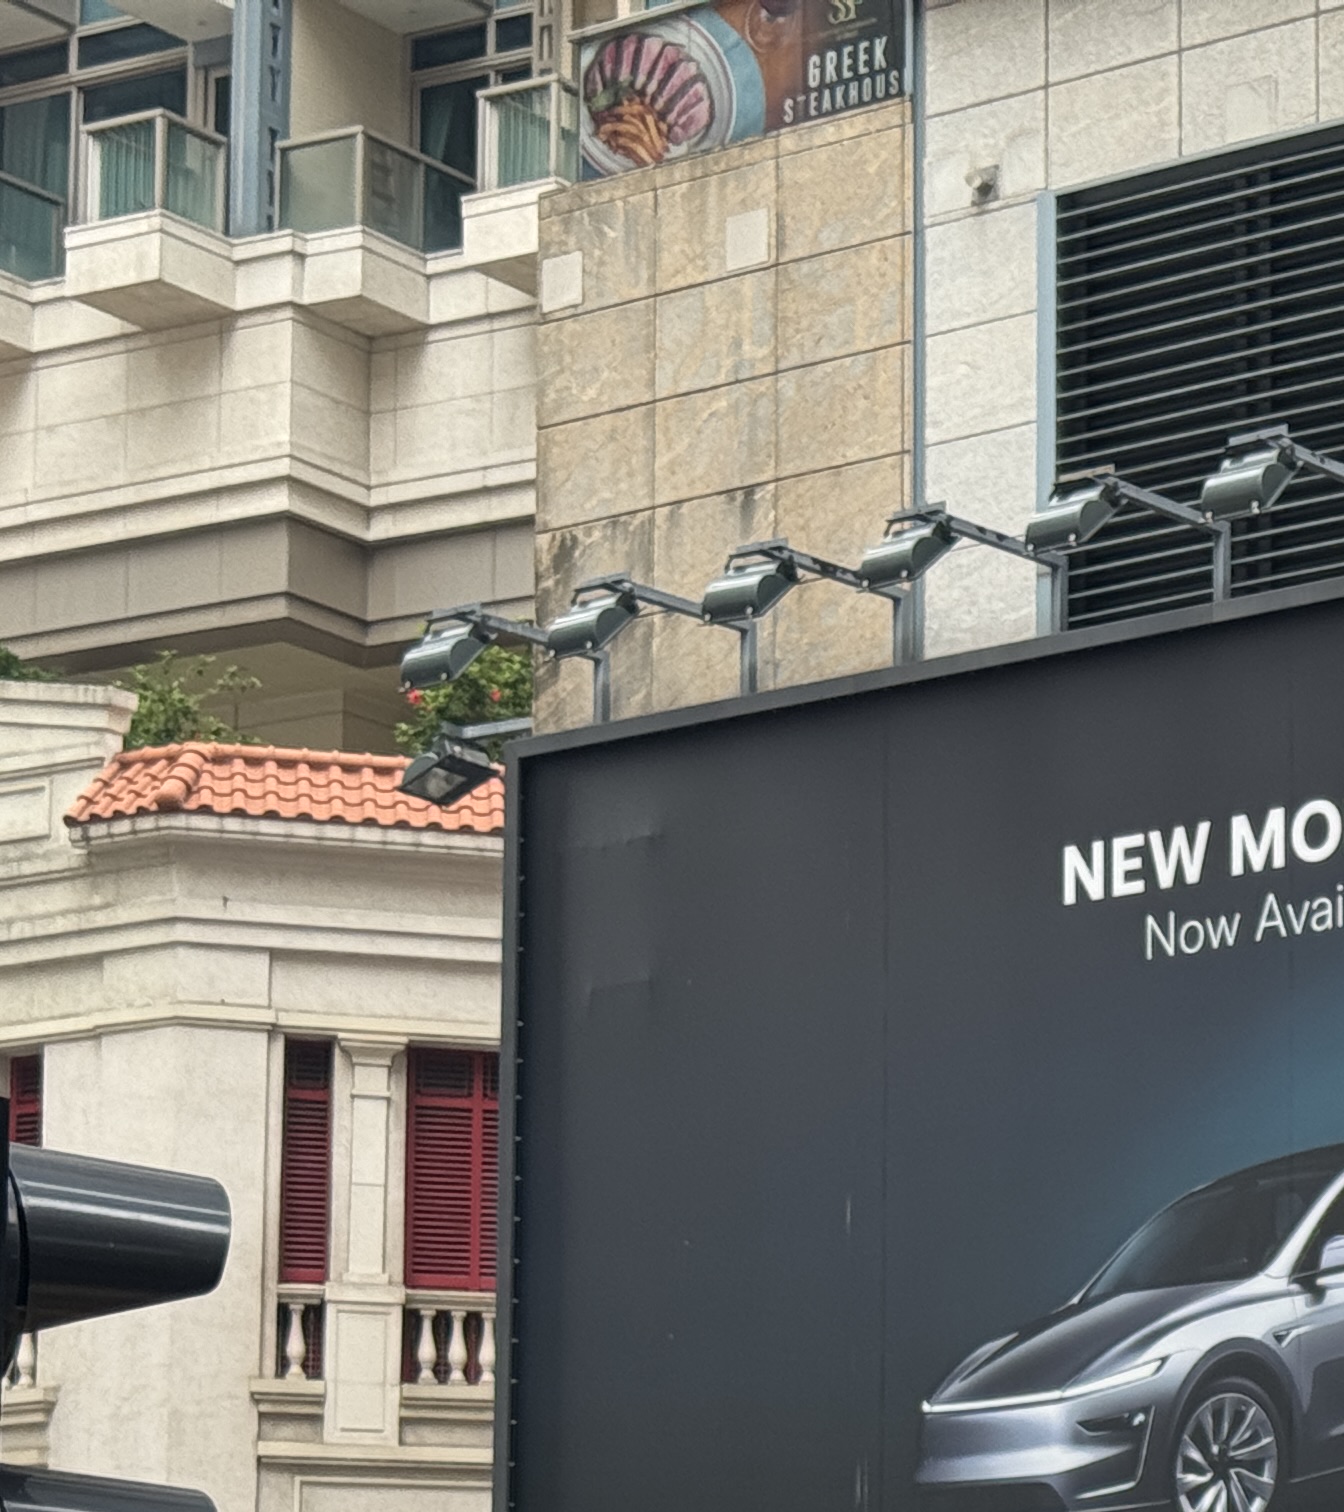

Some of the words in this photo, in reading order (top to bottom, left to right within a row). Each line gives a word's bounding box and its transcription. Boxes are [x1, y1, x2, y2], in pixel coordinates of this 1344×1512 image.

[808, 36, 888, 89] GREEK
[782, 70, 901, 124] STEAKHOUS
[1062, 820, 1211, 906] NEW
[1145, 910, 1242, 961] Now
